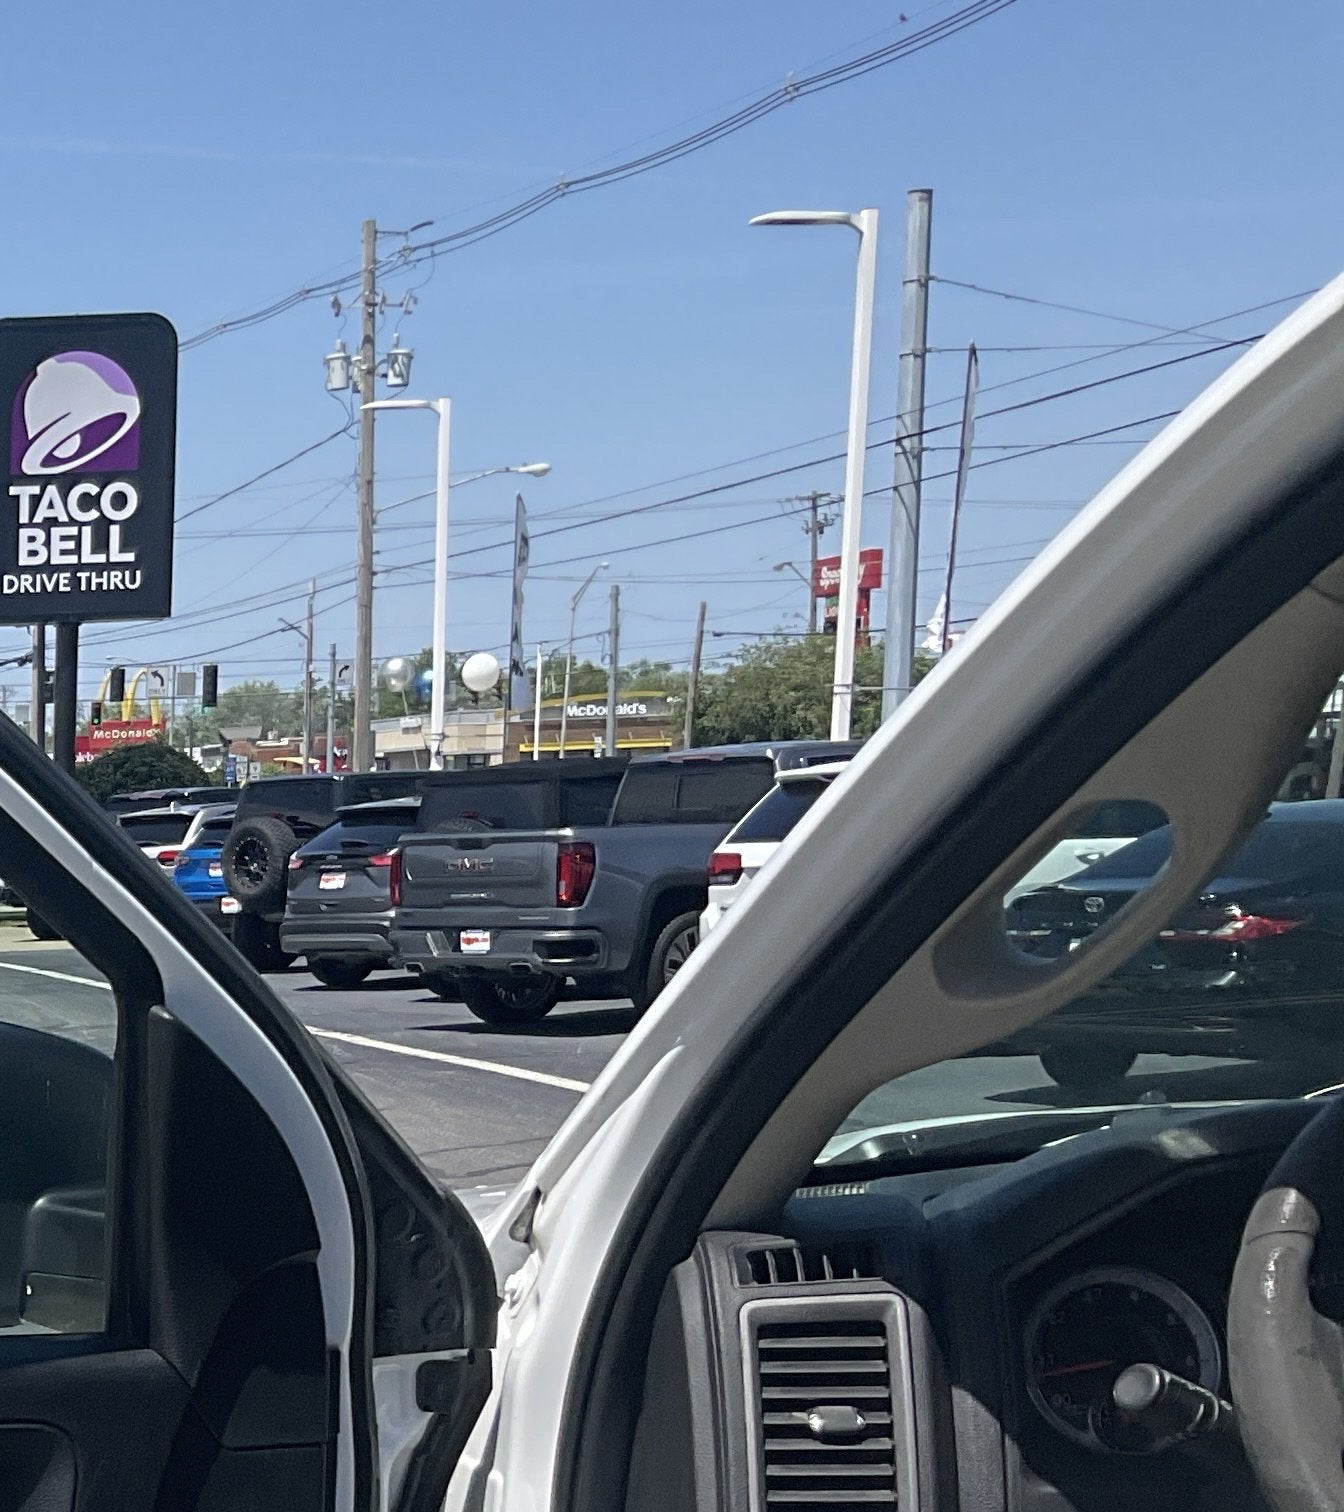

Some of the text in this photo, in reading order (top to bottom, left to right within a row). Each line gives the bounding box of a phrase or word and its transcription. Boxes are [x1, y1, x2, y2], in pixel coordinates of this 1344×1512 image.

[9, 481, 138, 524] TACO
[18, 524, 135, 566] BELL
[2, 570, 141, 594] DRIVE THRU
[567, 703, 647, 717] McDoald's
[93, 728, 161, 739] McDonald
